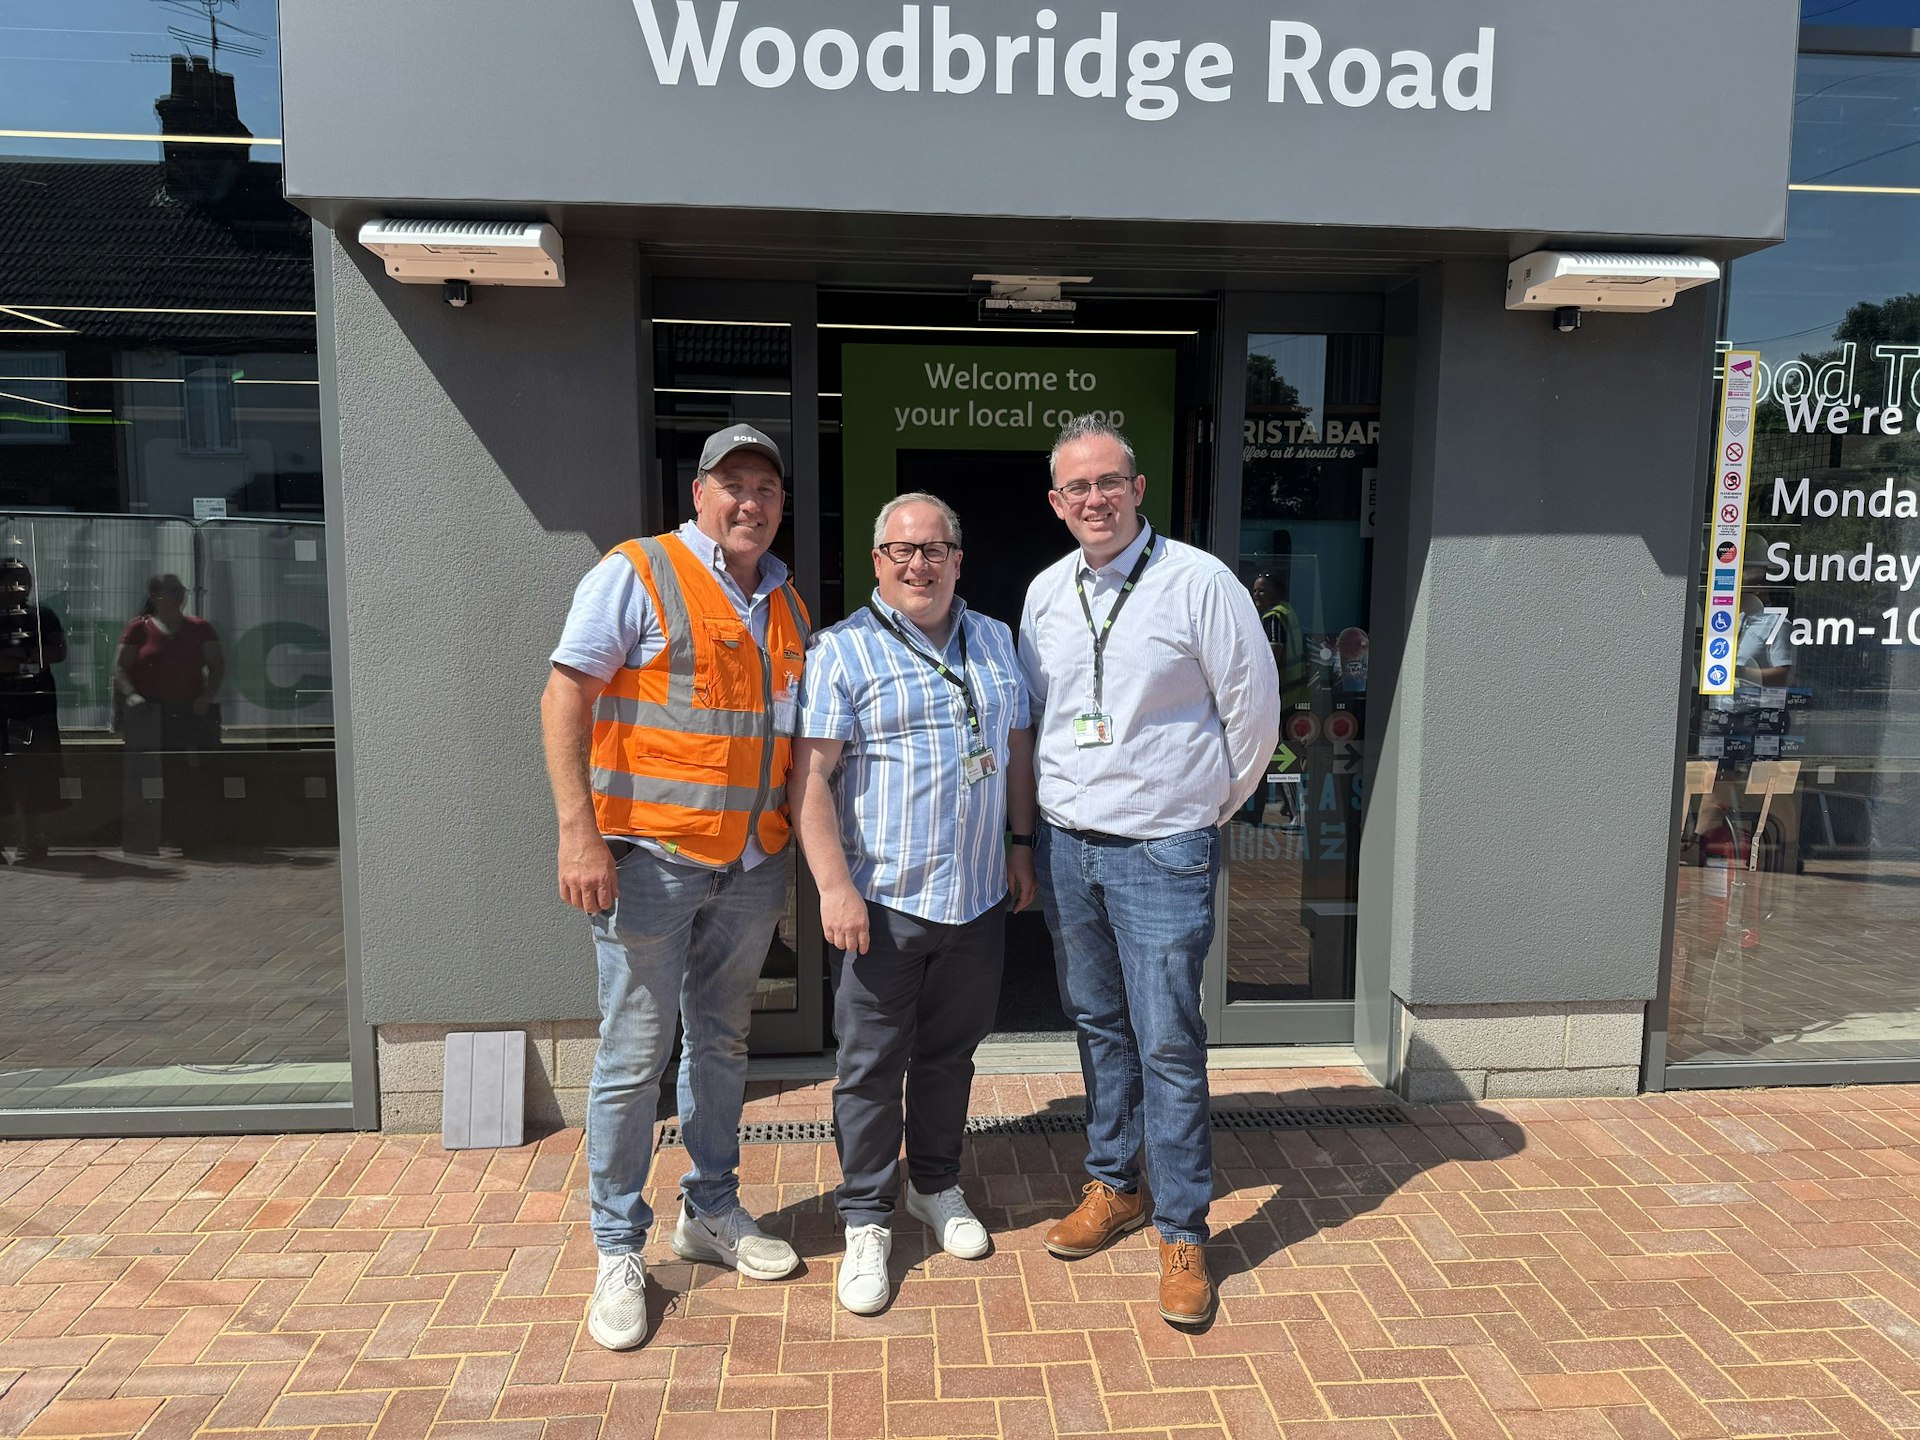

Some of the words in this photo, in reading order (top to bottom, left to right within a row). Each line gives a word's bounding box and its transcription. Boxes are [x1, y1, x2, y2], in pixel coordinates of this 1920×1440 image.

[633, 0, 1233, 121] Woodbridge
[1268, 20, 1495, 111] Road
[924, 362, 1058, 391] Welcome
[1065, 368, 1097, 392] to
[894, 406, 960, 432] your
[968, 400, 1034, 428] local
[1042, 409, 1125, 429] coop
[1242, 420, 1322, 444] RISTA
[1326, 421, 1380, 445] BAR
[1782, 394, 1903, 435] We're
[1295, 446, 1338, 459] should
[1340, 446, 1356, 459] be
[1771, 477, 1918, 518] Monda
[1765, 542, 1920, 592] Sunday
